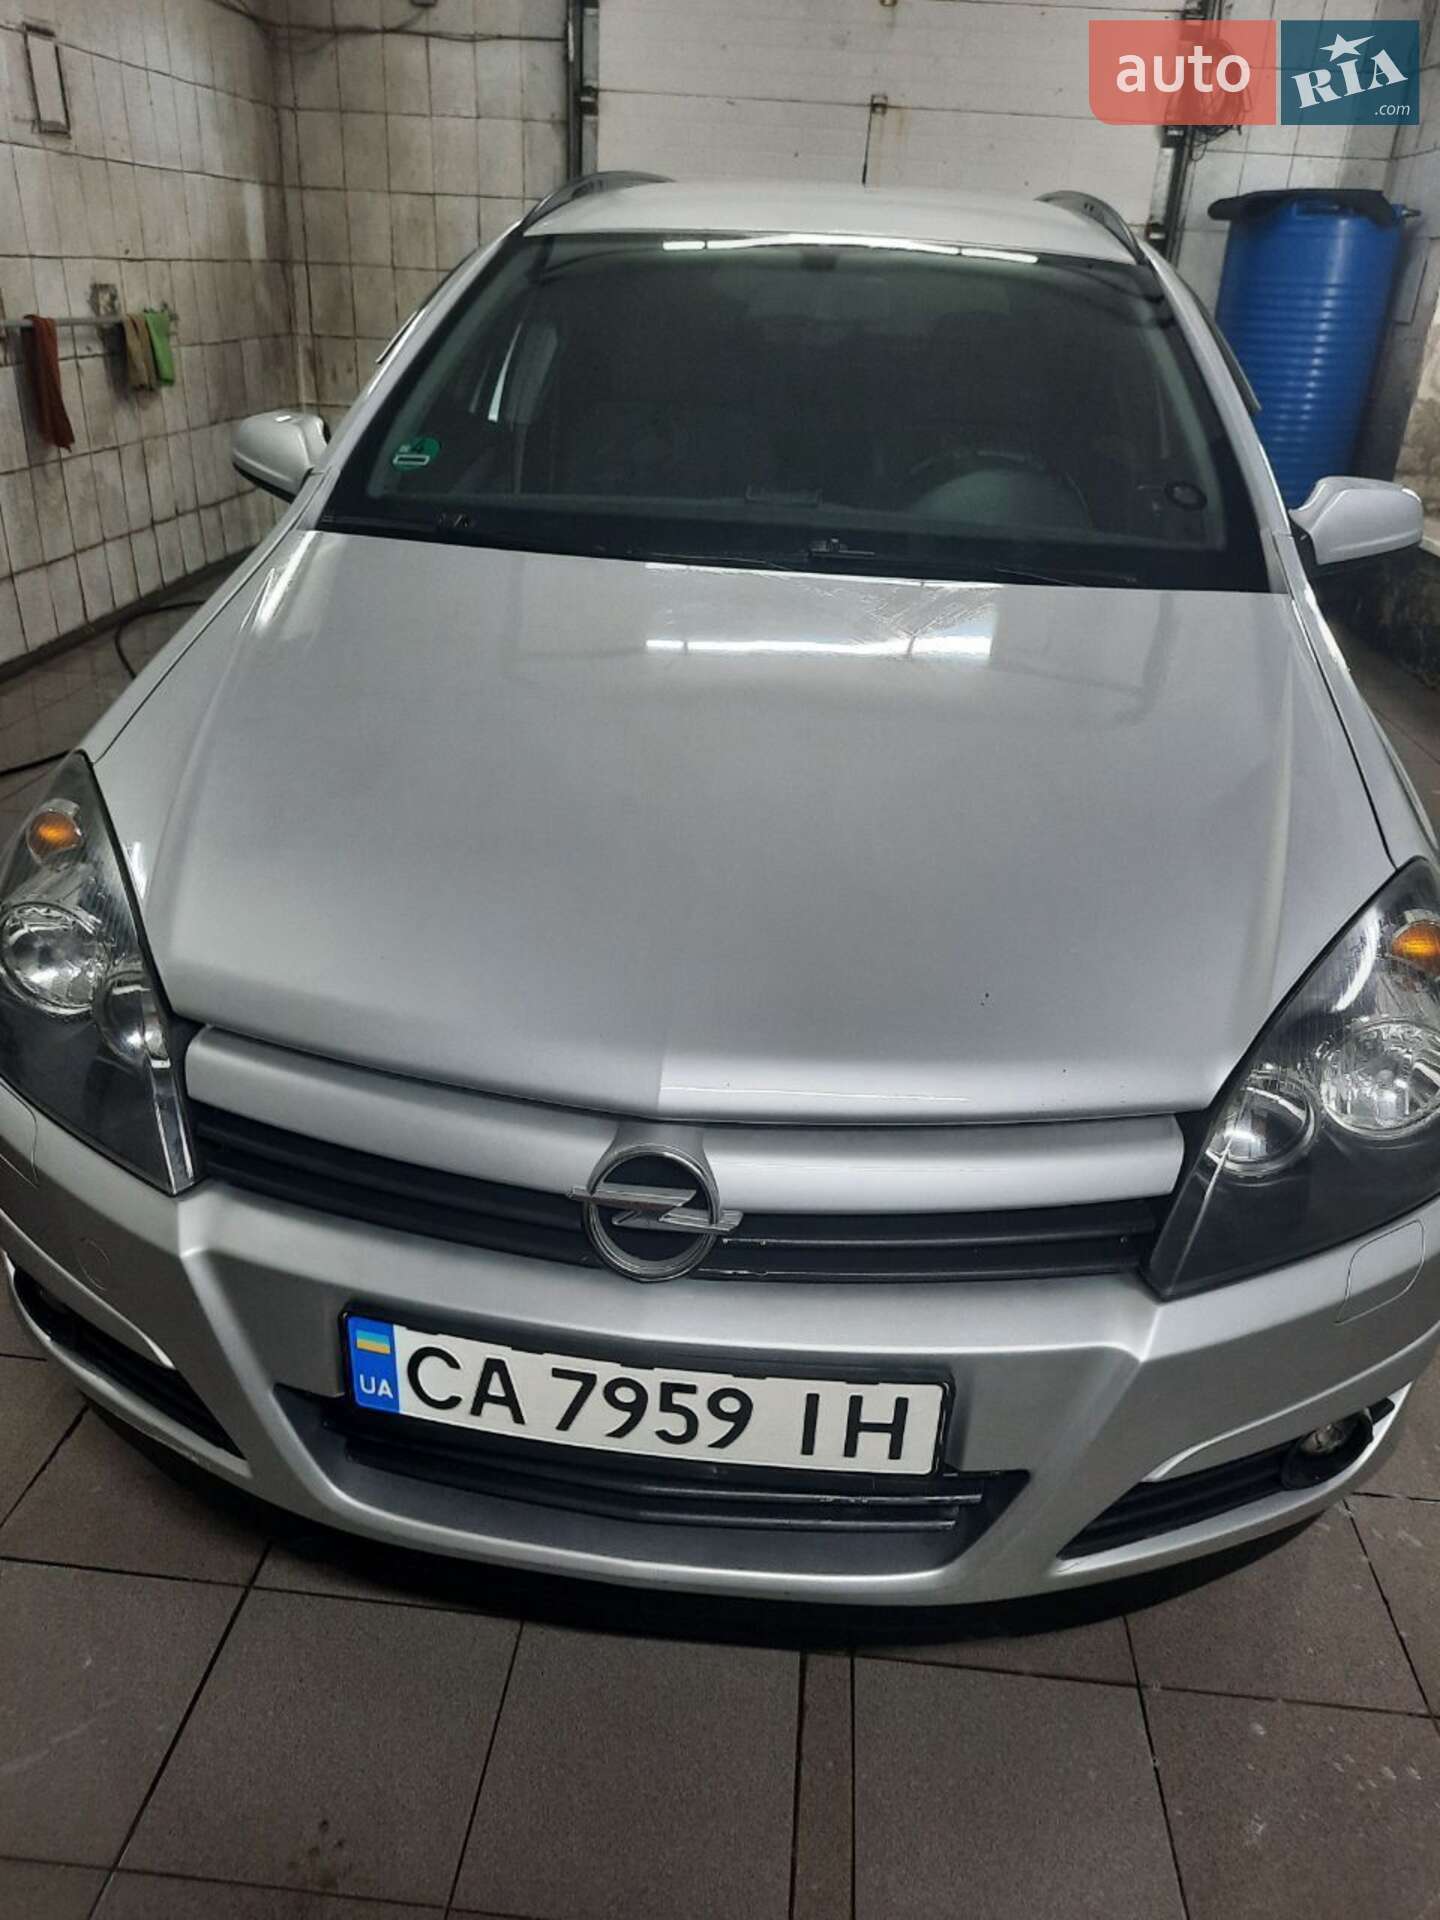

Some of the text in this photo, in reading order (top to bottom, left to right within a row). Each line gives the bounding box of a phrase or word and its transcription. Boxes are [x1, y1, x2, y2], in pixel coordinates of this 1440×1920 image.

[360, 1374, 393, 1399] UA
[406, 1346, 909, 1460] CA 7959 IH
